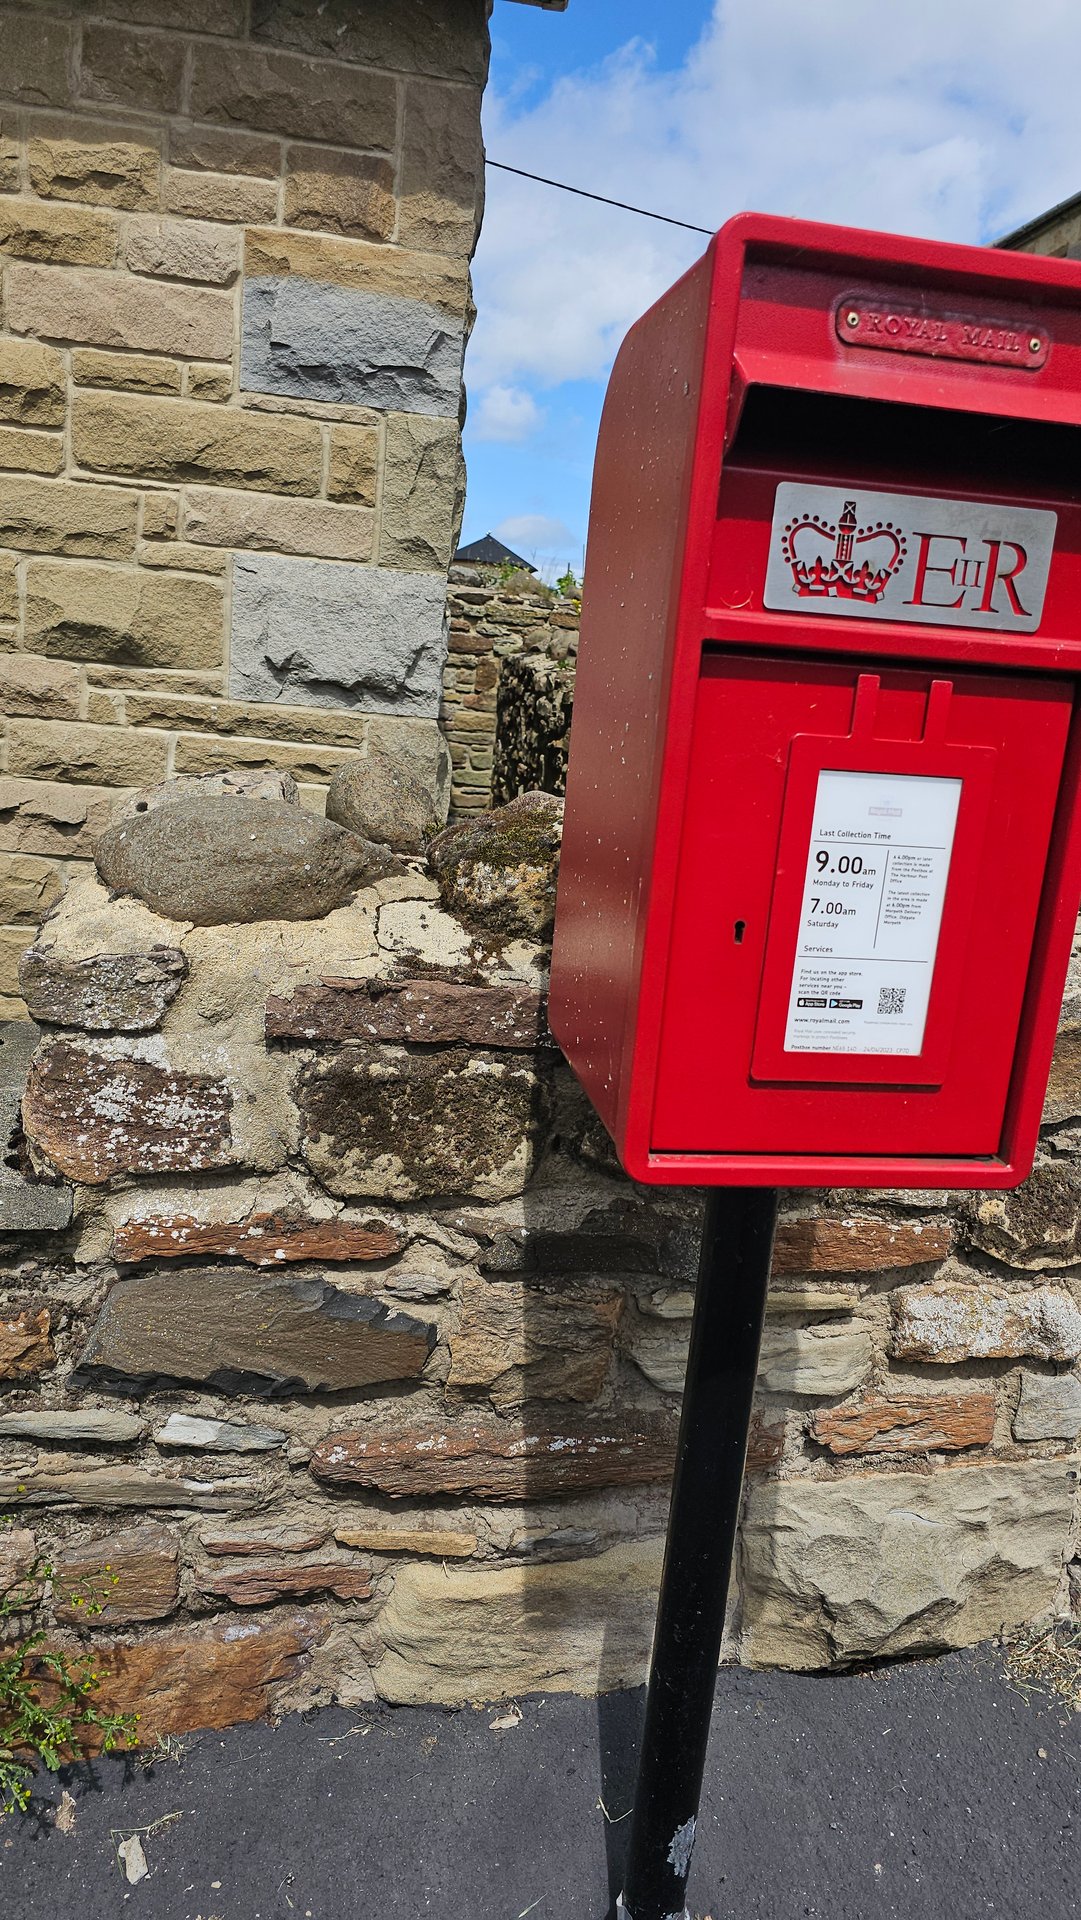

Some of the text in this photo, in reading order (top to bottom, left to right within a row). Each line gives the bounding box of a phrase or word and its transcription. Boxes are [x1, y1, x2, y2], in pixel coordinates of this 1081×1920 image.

[868, 313, 1020, 351] ROYAL MAIL
[838, 830, 871, 839] Collection
[816, 851, 876, 875] 9.00am
[813, 880, 840, 888] Monday
[852, 881, 873, 889] Friday
[810, 899, 856, 915] 7.00am
[808, 920, 838, 928] Saturday
